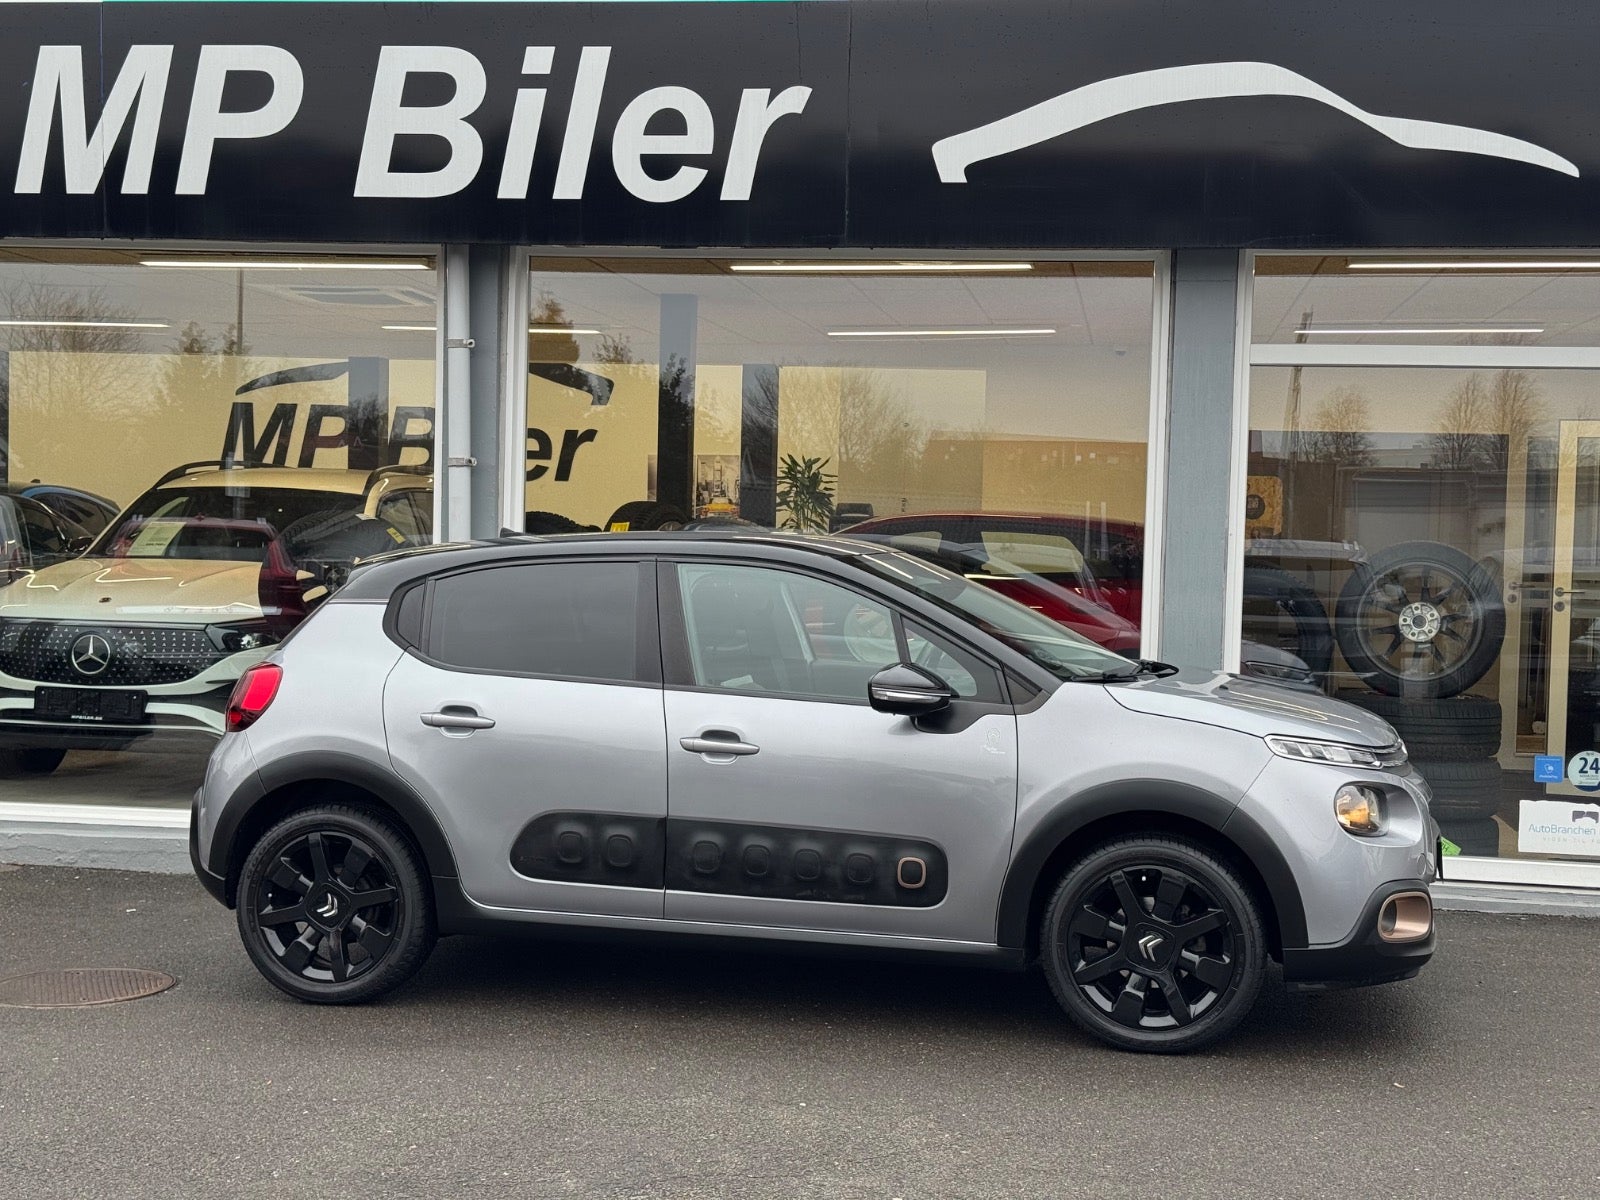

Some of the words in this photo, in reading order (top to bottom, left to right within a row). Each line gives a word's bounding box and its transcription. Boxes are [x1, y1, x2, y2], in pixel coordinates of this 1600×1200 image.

[15, 44, 304, 195] MP
[354, 44, 813, 203] Biler
[388, 406, 599, 482] Ber
[1578, 756, 1600, 774] 24
[1528, 823, 1596, 835] AutoBranchen
